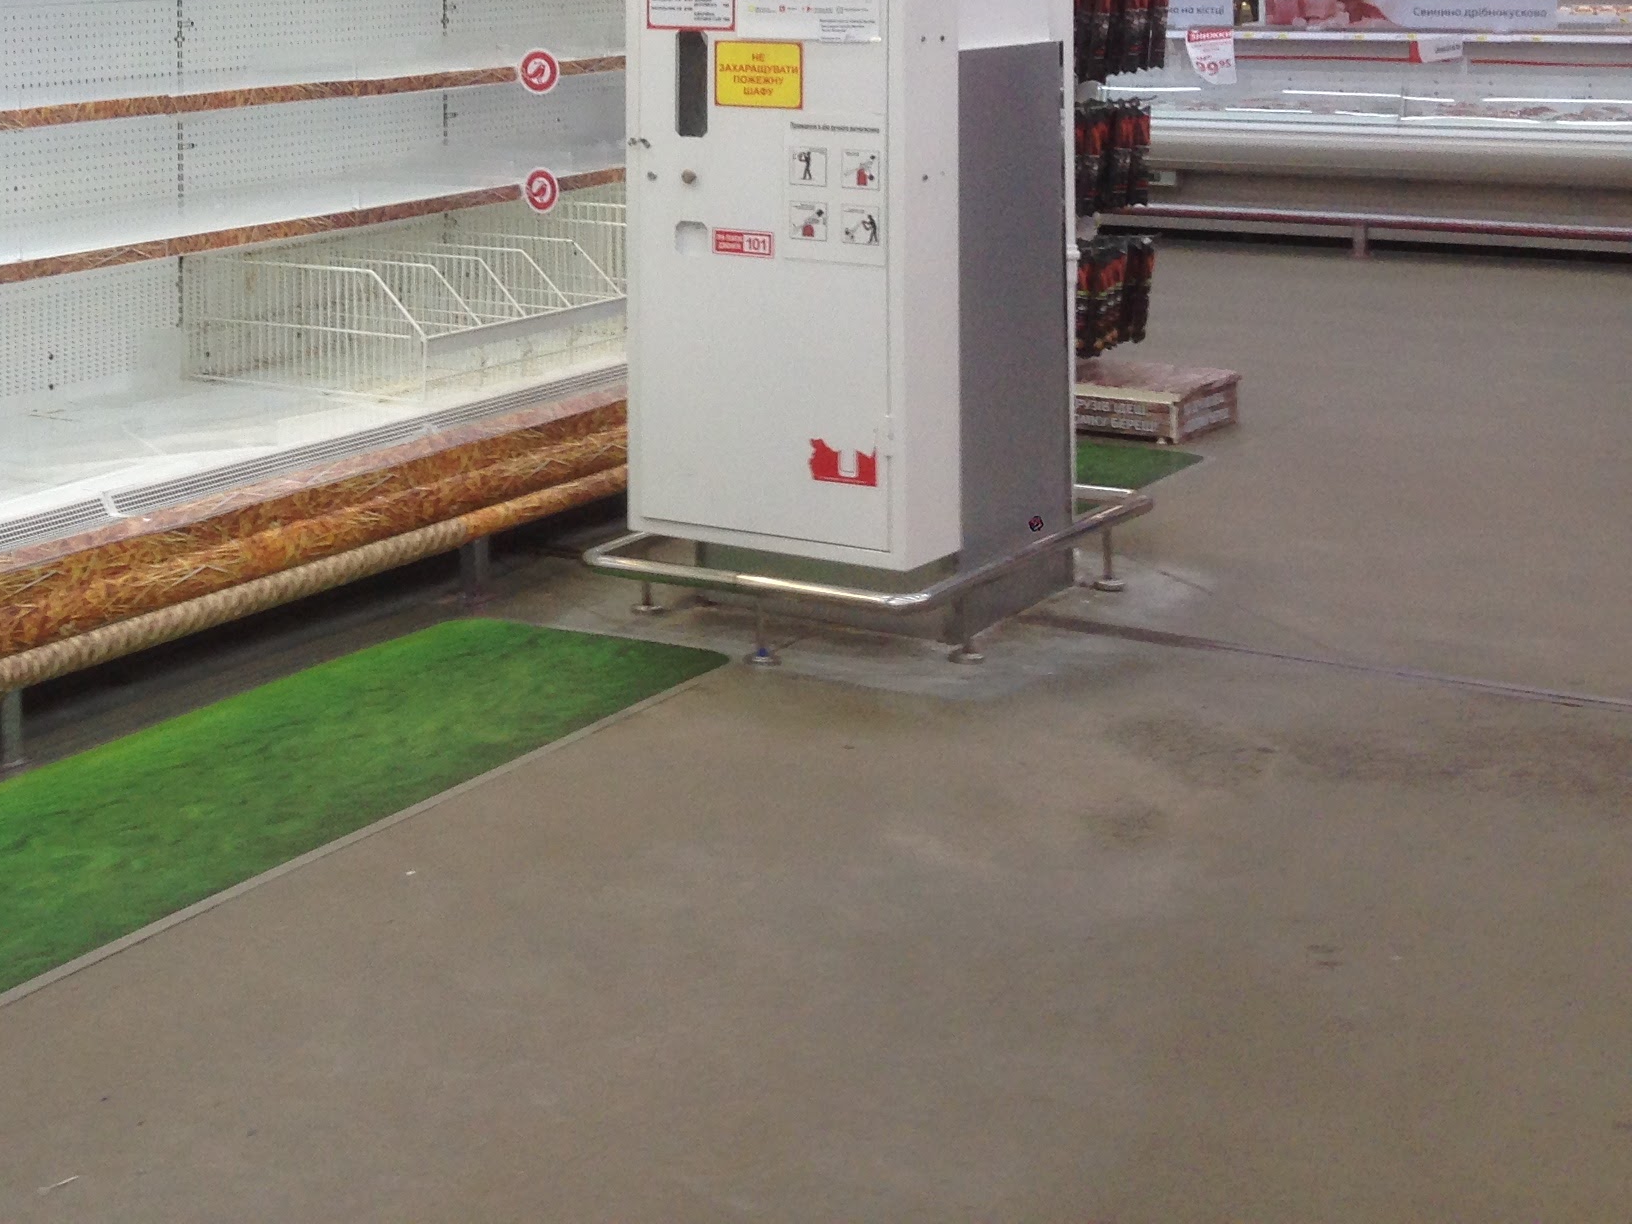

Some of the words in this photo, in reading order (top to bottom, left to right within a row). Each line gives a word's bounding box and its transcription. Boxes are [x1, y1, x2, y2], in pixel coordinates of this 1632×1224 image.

[752, 53, 765, 62] НЕ
[719, 64, 798, 74] ЗАХАРАЩУВАТИ
[733, 75, 784, 85] ПОЖЕЖНУ
[743, 87, 773, 96] ШАФУ
[746, 237, 767, 251] 101
